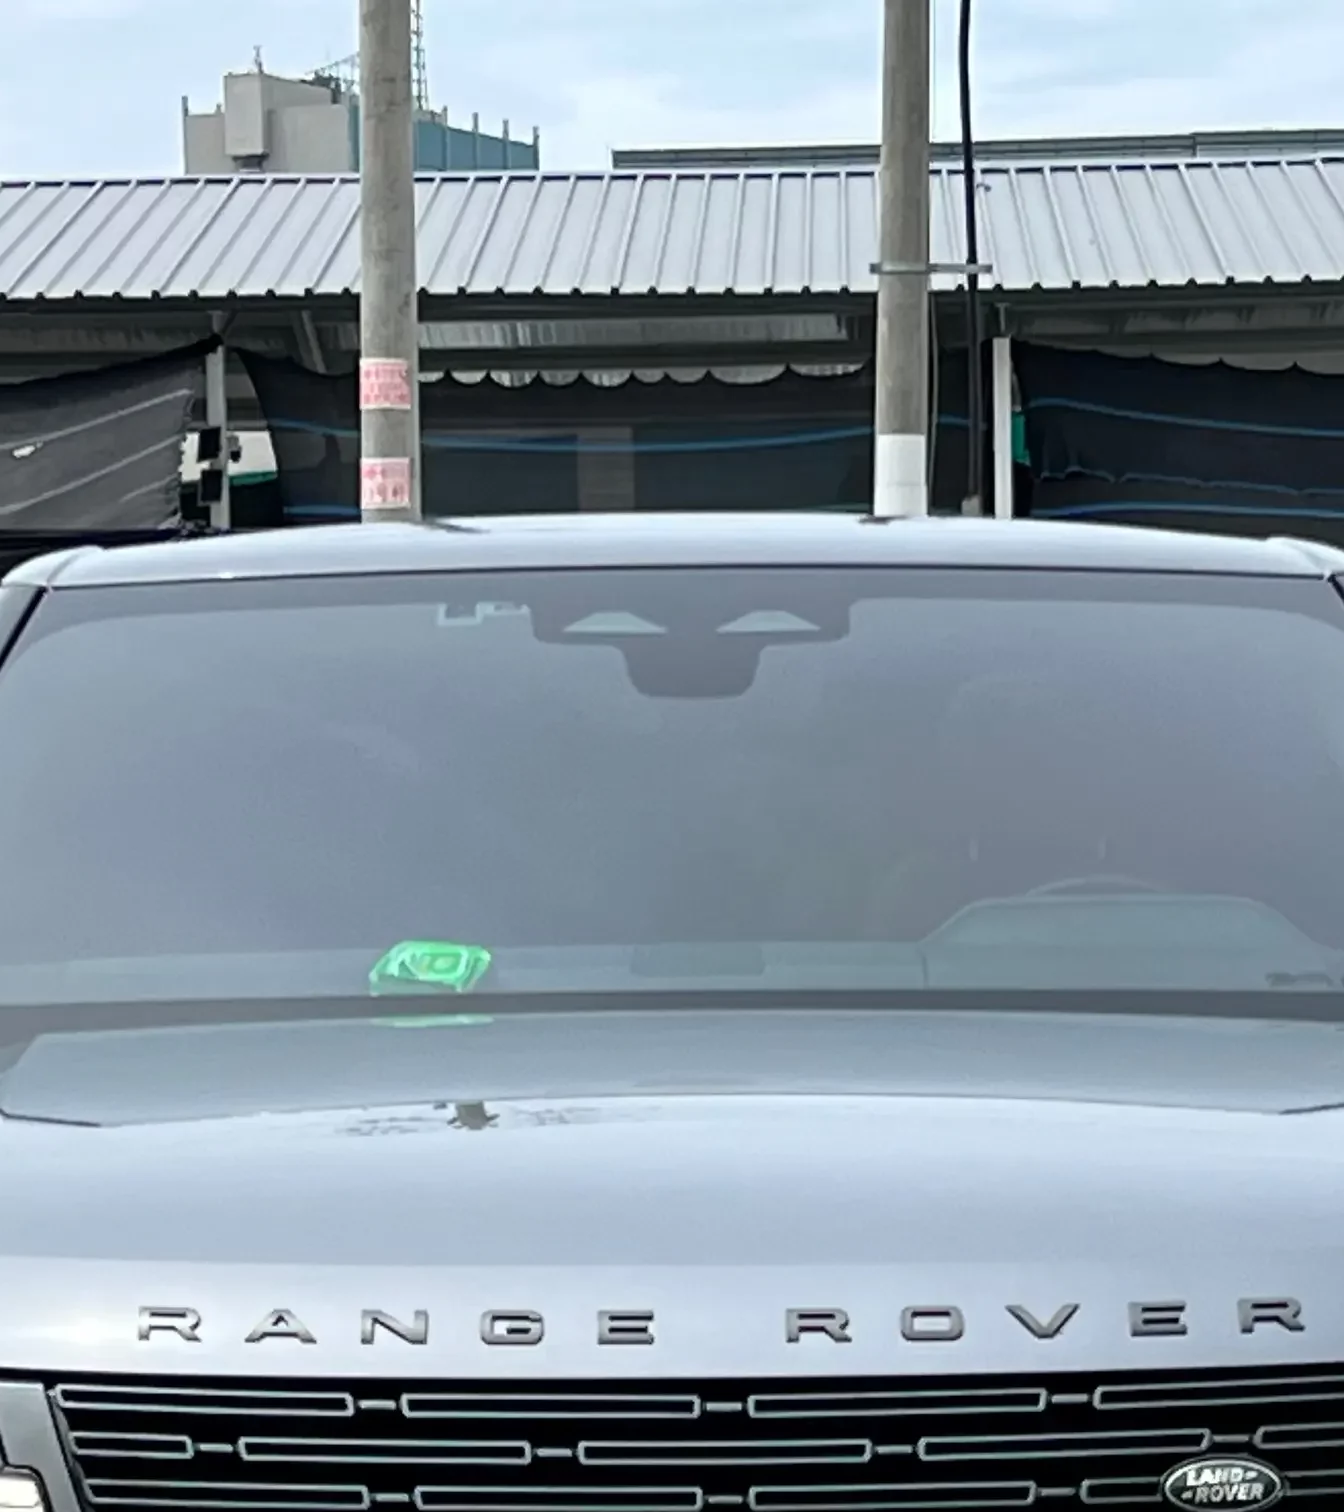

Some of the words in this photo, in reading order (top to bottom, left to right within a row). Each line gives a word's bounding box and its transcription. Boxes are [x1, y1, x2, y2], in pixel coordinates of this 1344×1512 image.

[137, 1305, 656, 1347] RANGE
[784, 1296, 1305, 1345] ROVER
[1186, 1467, 1244, 1486] LAND
[1194, 1483, 1265, 1504] ROVER
